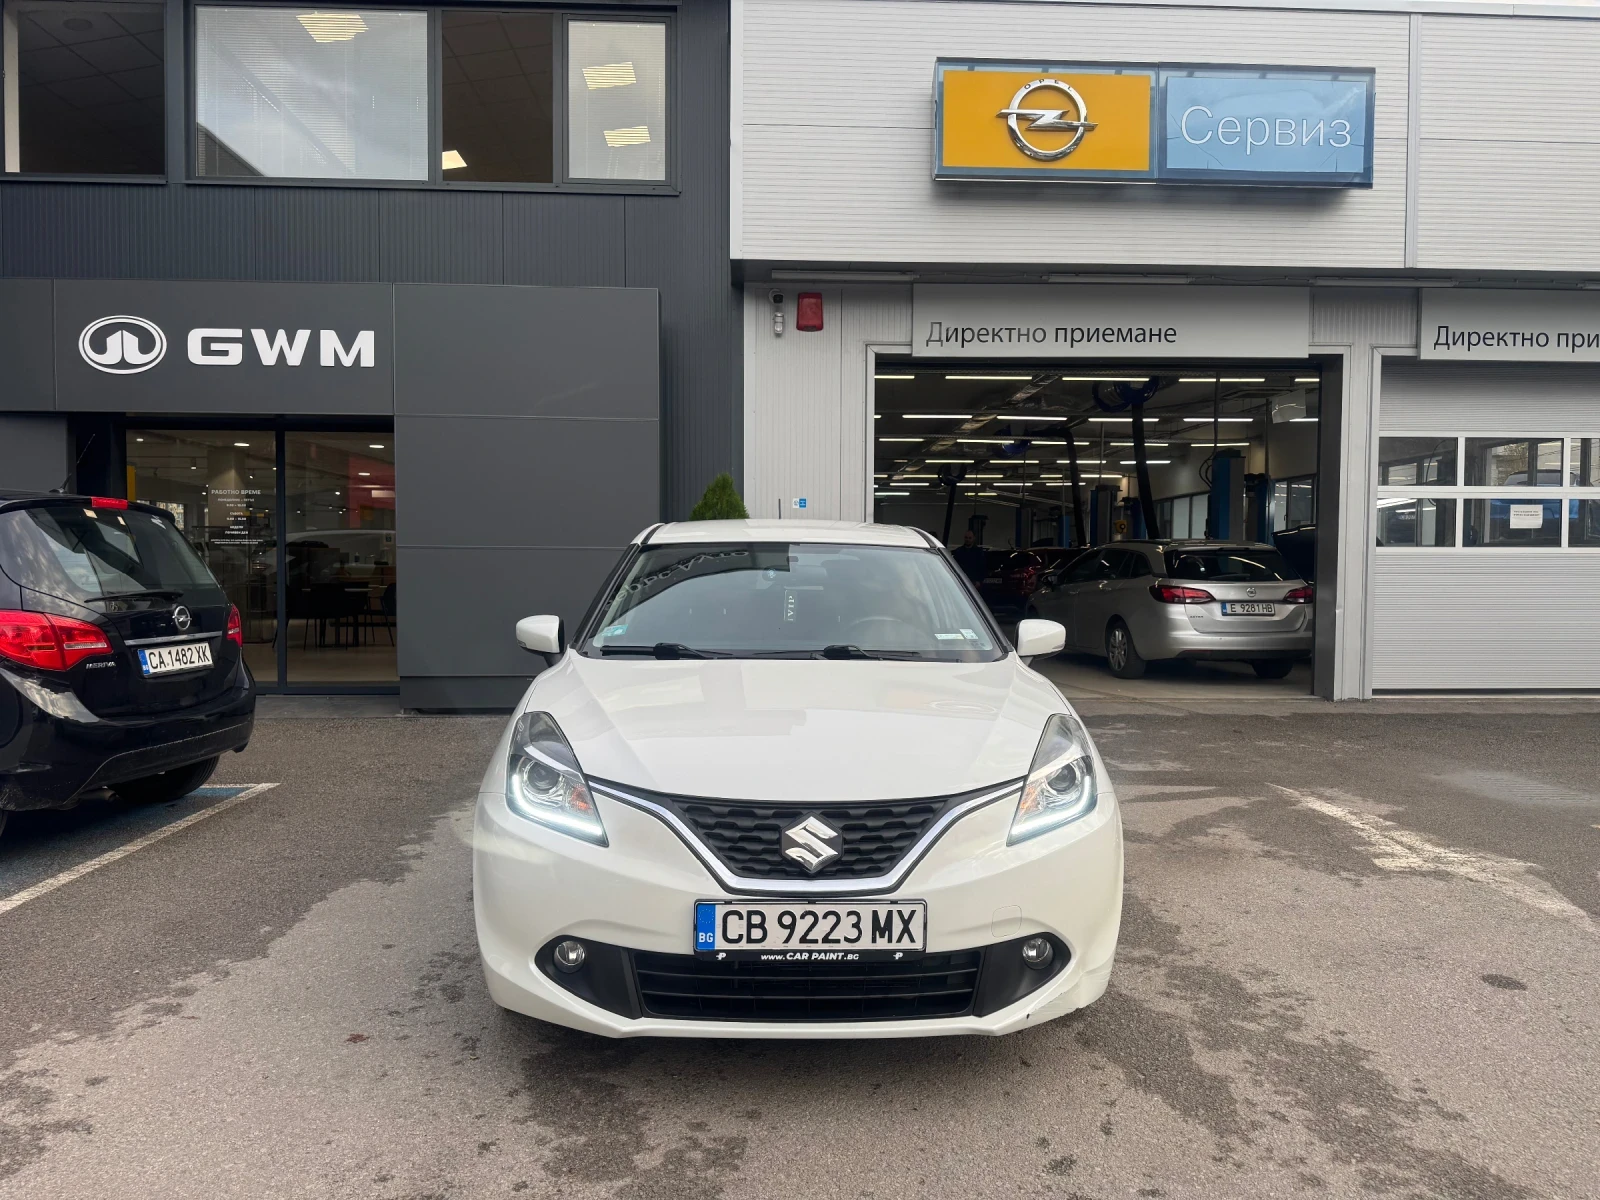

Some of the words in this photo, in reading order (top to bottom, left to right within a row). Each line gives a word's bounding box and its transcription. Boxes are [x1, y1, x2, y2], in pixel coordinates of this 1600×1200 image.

[1024, 78, 1072, 91] OPEL
[1180, 105, 1352, 156] Сервиз
[187, 328, 375, 367] GWM
[926, 321, 1047, 348] Директно
[1054, 327, 1178, 348] приемане
[1433, 325, 1550, 352] Директно
[1230, 603, 1237, 613] E
[1240, 603, 1260, 613] 9281
[1261, 603, 1273, 612] HB
[85, 661, 116, 670] MERIVA
[148, 651, 167, 670] CA
[167, 647, 195, 667] 1482
[195, 644, 210, 664] XK
[698, 932, 714, 943] BG
[721, 909, 768, 945] CB
[777, 909, 863, 945] 9223
[871, 909, 917, 944] MX
